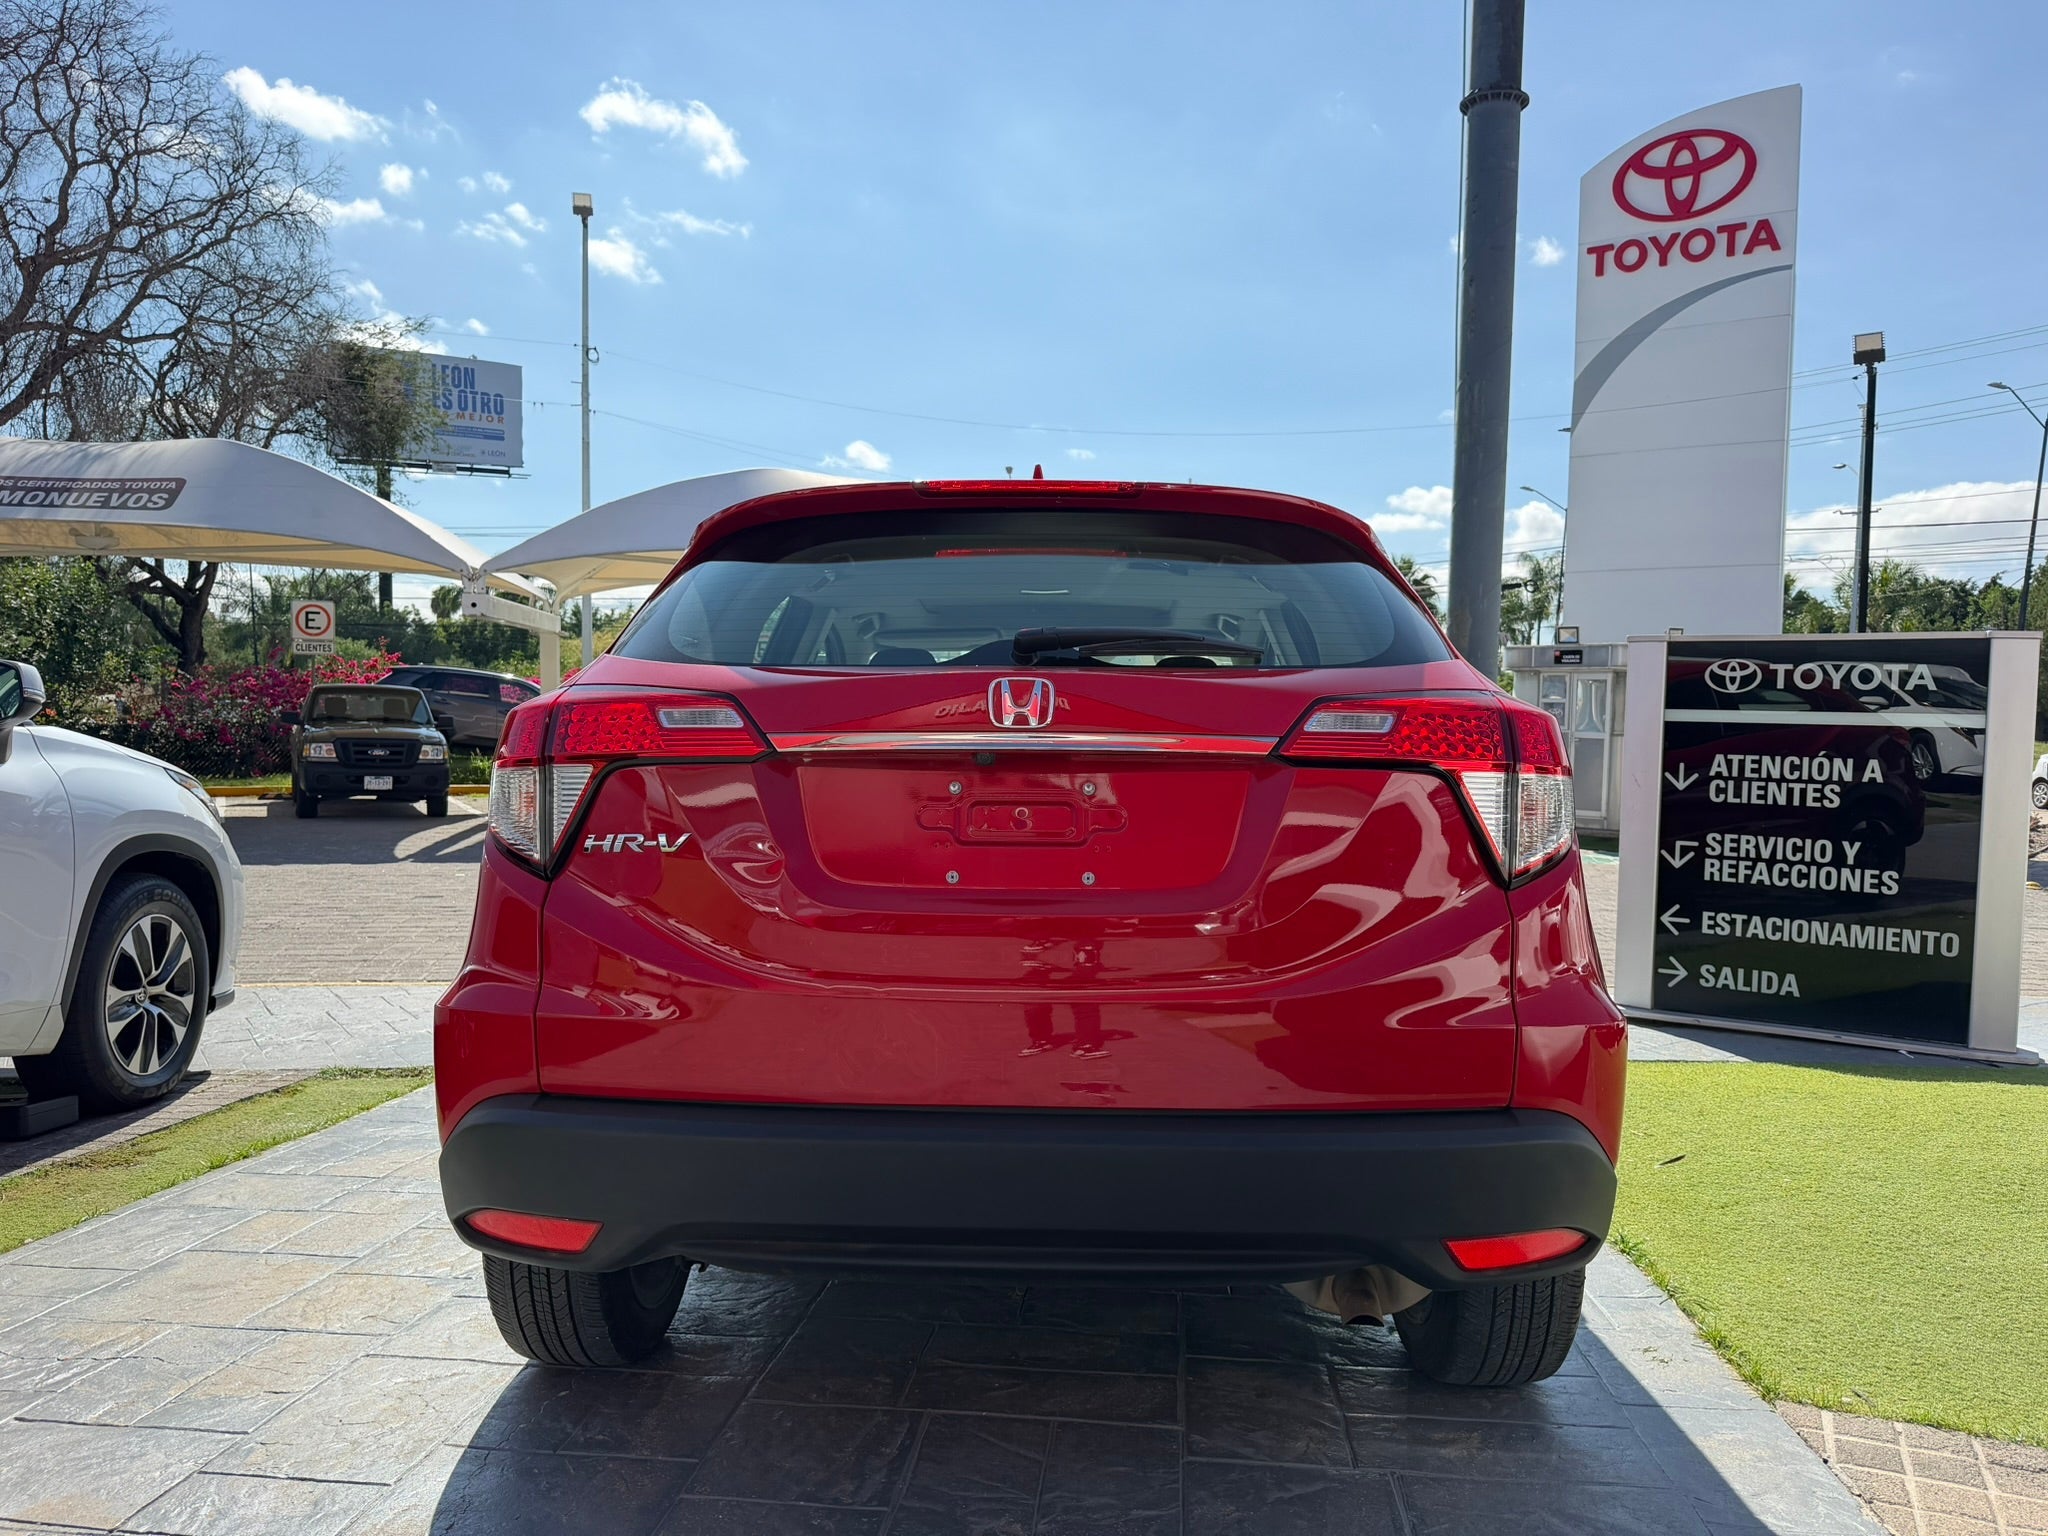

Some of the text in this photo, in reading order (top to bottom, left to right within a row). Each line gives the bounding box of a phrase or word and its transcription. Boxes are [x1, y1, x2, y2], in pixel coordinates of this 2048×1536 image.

[1586, 218, 1782, 278] TOYOTA
[457, 389, 505, 416] OTRO
[456, 412, 505, 424] MEJOR
[17, 479, 121, 489] CERTIFICADOS
[121, 481, 177, 490] TOYOTA
[305, 611, 321, 630] E
[295, 643, 332, 653] CLIENTES
[1769, 663, 1938, 691] TOYOTA
[1709, 750, 1884, 784] ATENCIÓN A
[1709, 779, 1842, 809] CLIENTES
[583, 832, 692, 853] HR-V
[1705, 832, 1862, 865] SERVICIO Y
[1703, 858, 1900, 896] REFACCIONES
[1701, 911, 1960, 958] ESTACIONAMIENTO
[1698, 963, 1801, 998] SALIDA
